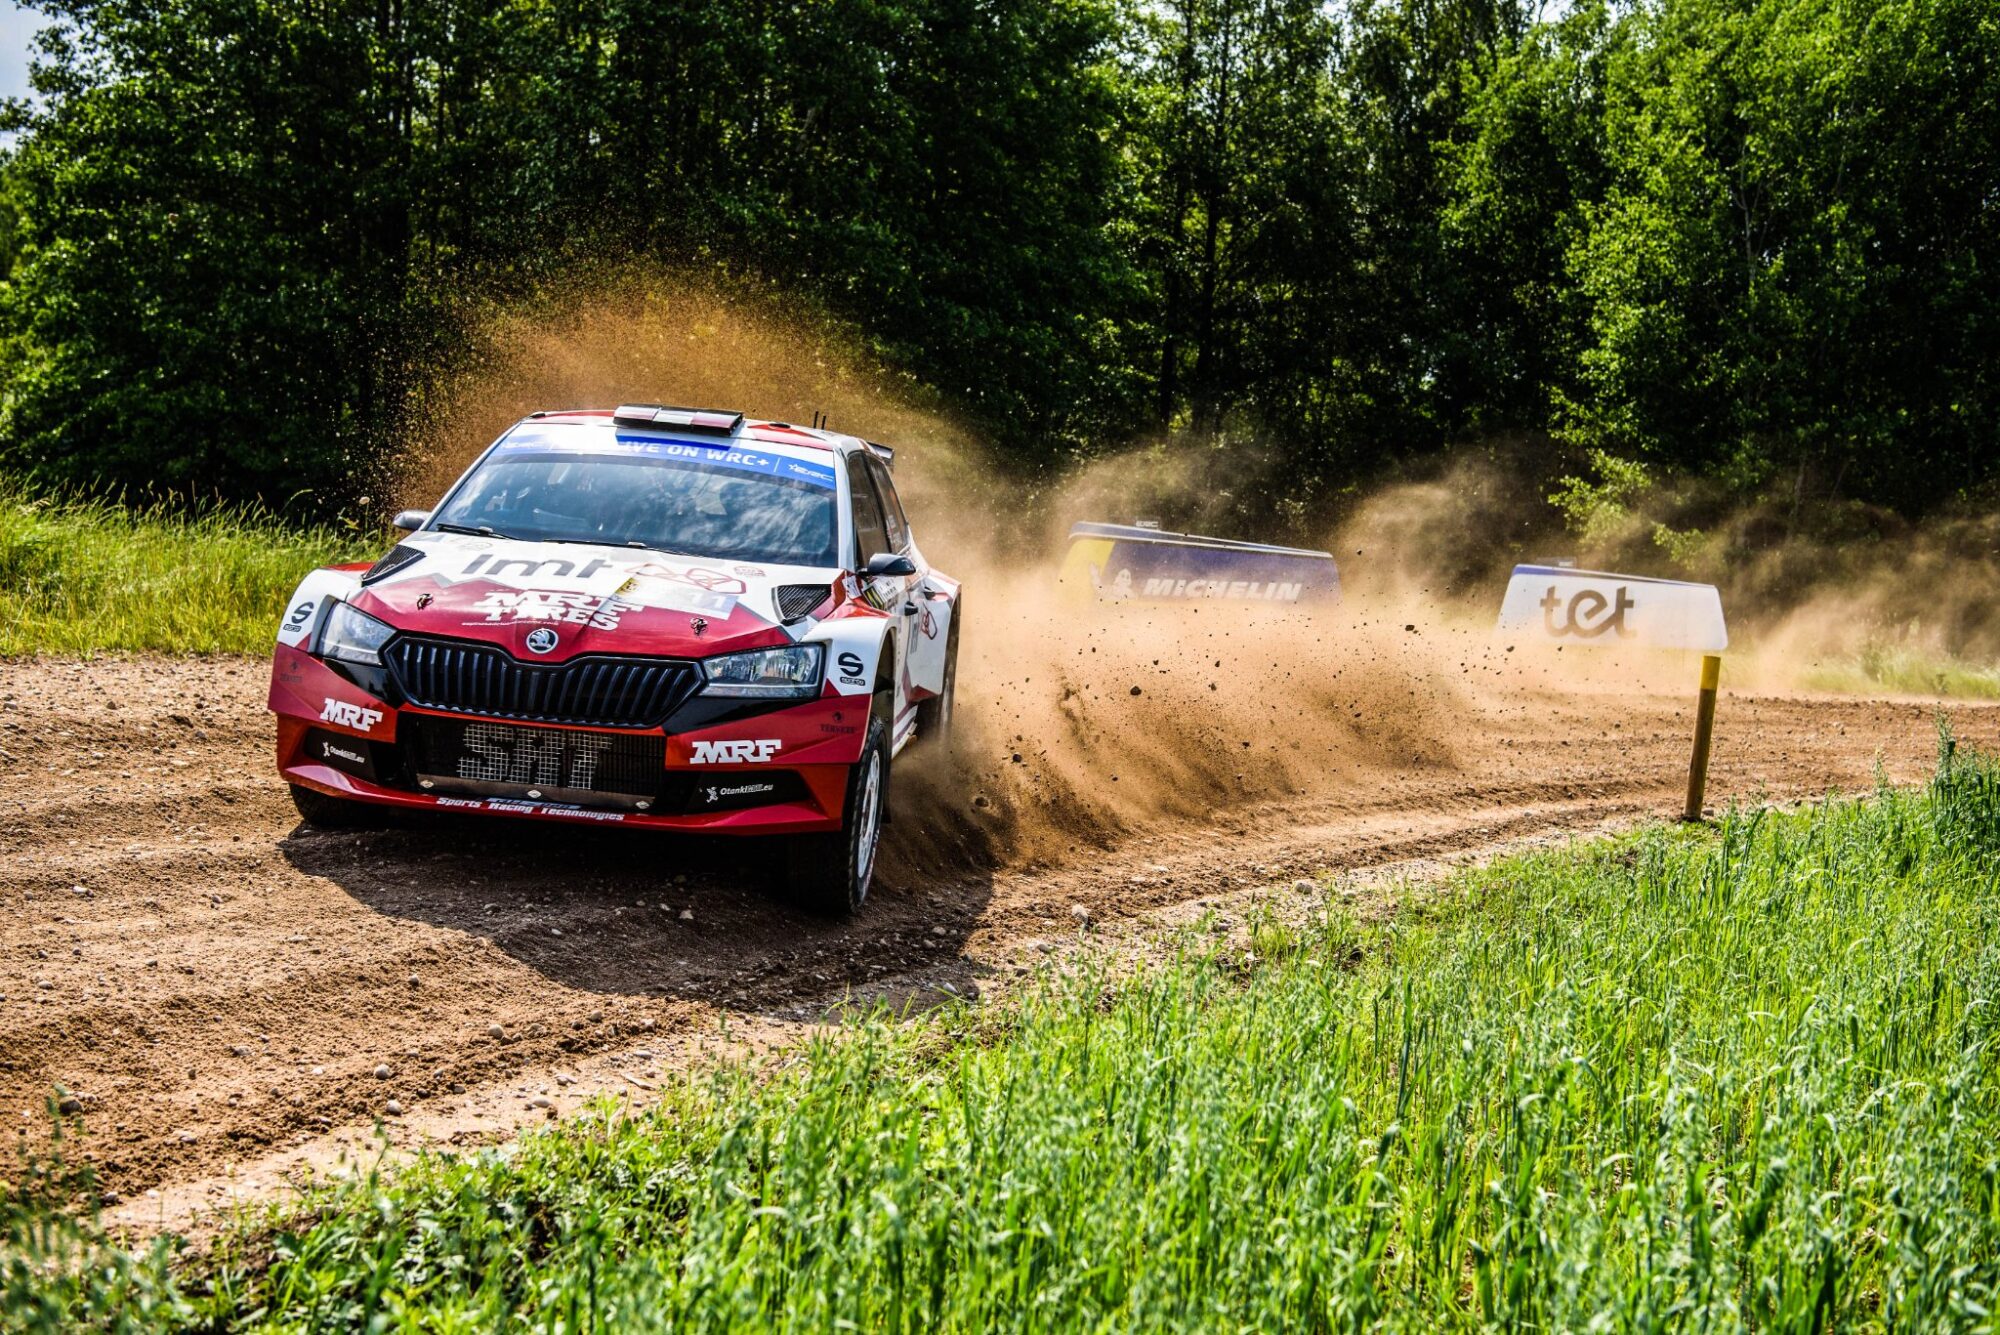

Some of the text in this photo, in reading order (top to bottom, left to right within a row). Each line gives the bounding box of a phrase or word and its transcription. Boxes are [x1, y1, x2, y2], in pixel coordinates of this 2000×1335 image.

[667, 444, 699, 457] ON
[706, 447, 770, 467] WRC+
[1143, 577, 1303, 601] MICHELIN
[473, 591, 645, 617] MRF
[1540, 585, 1637, 639] tet
[319, 697, 383, 732] MRF
[689, 738, 782, 765] MRF
[436, 796, 483, 810] Sports
[488, 802, 534, 814] Racing
[541, 807, 625, 822] Technologies
